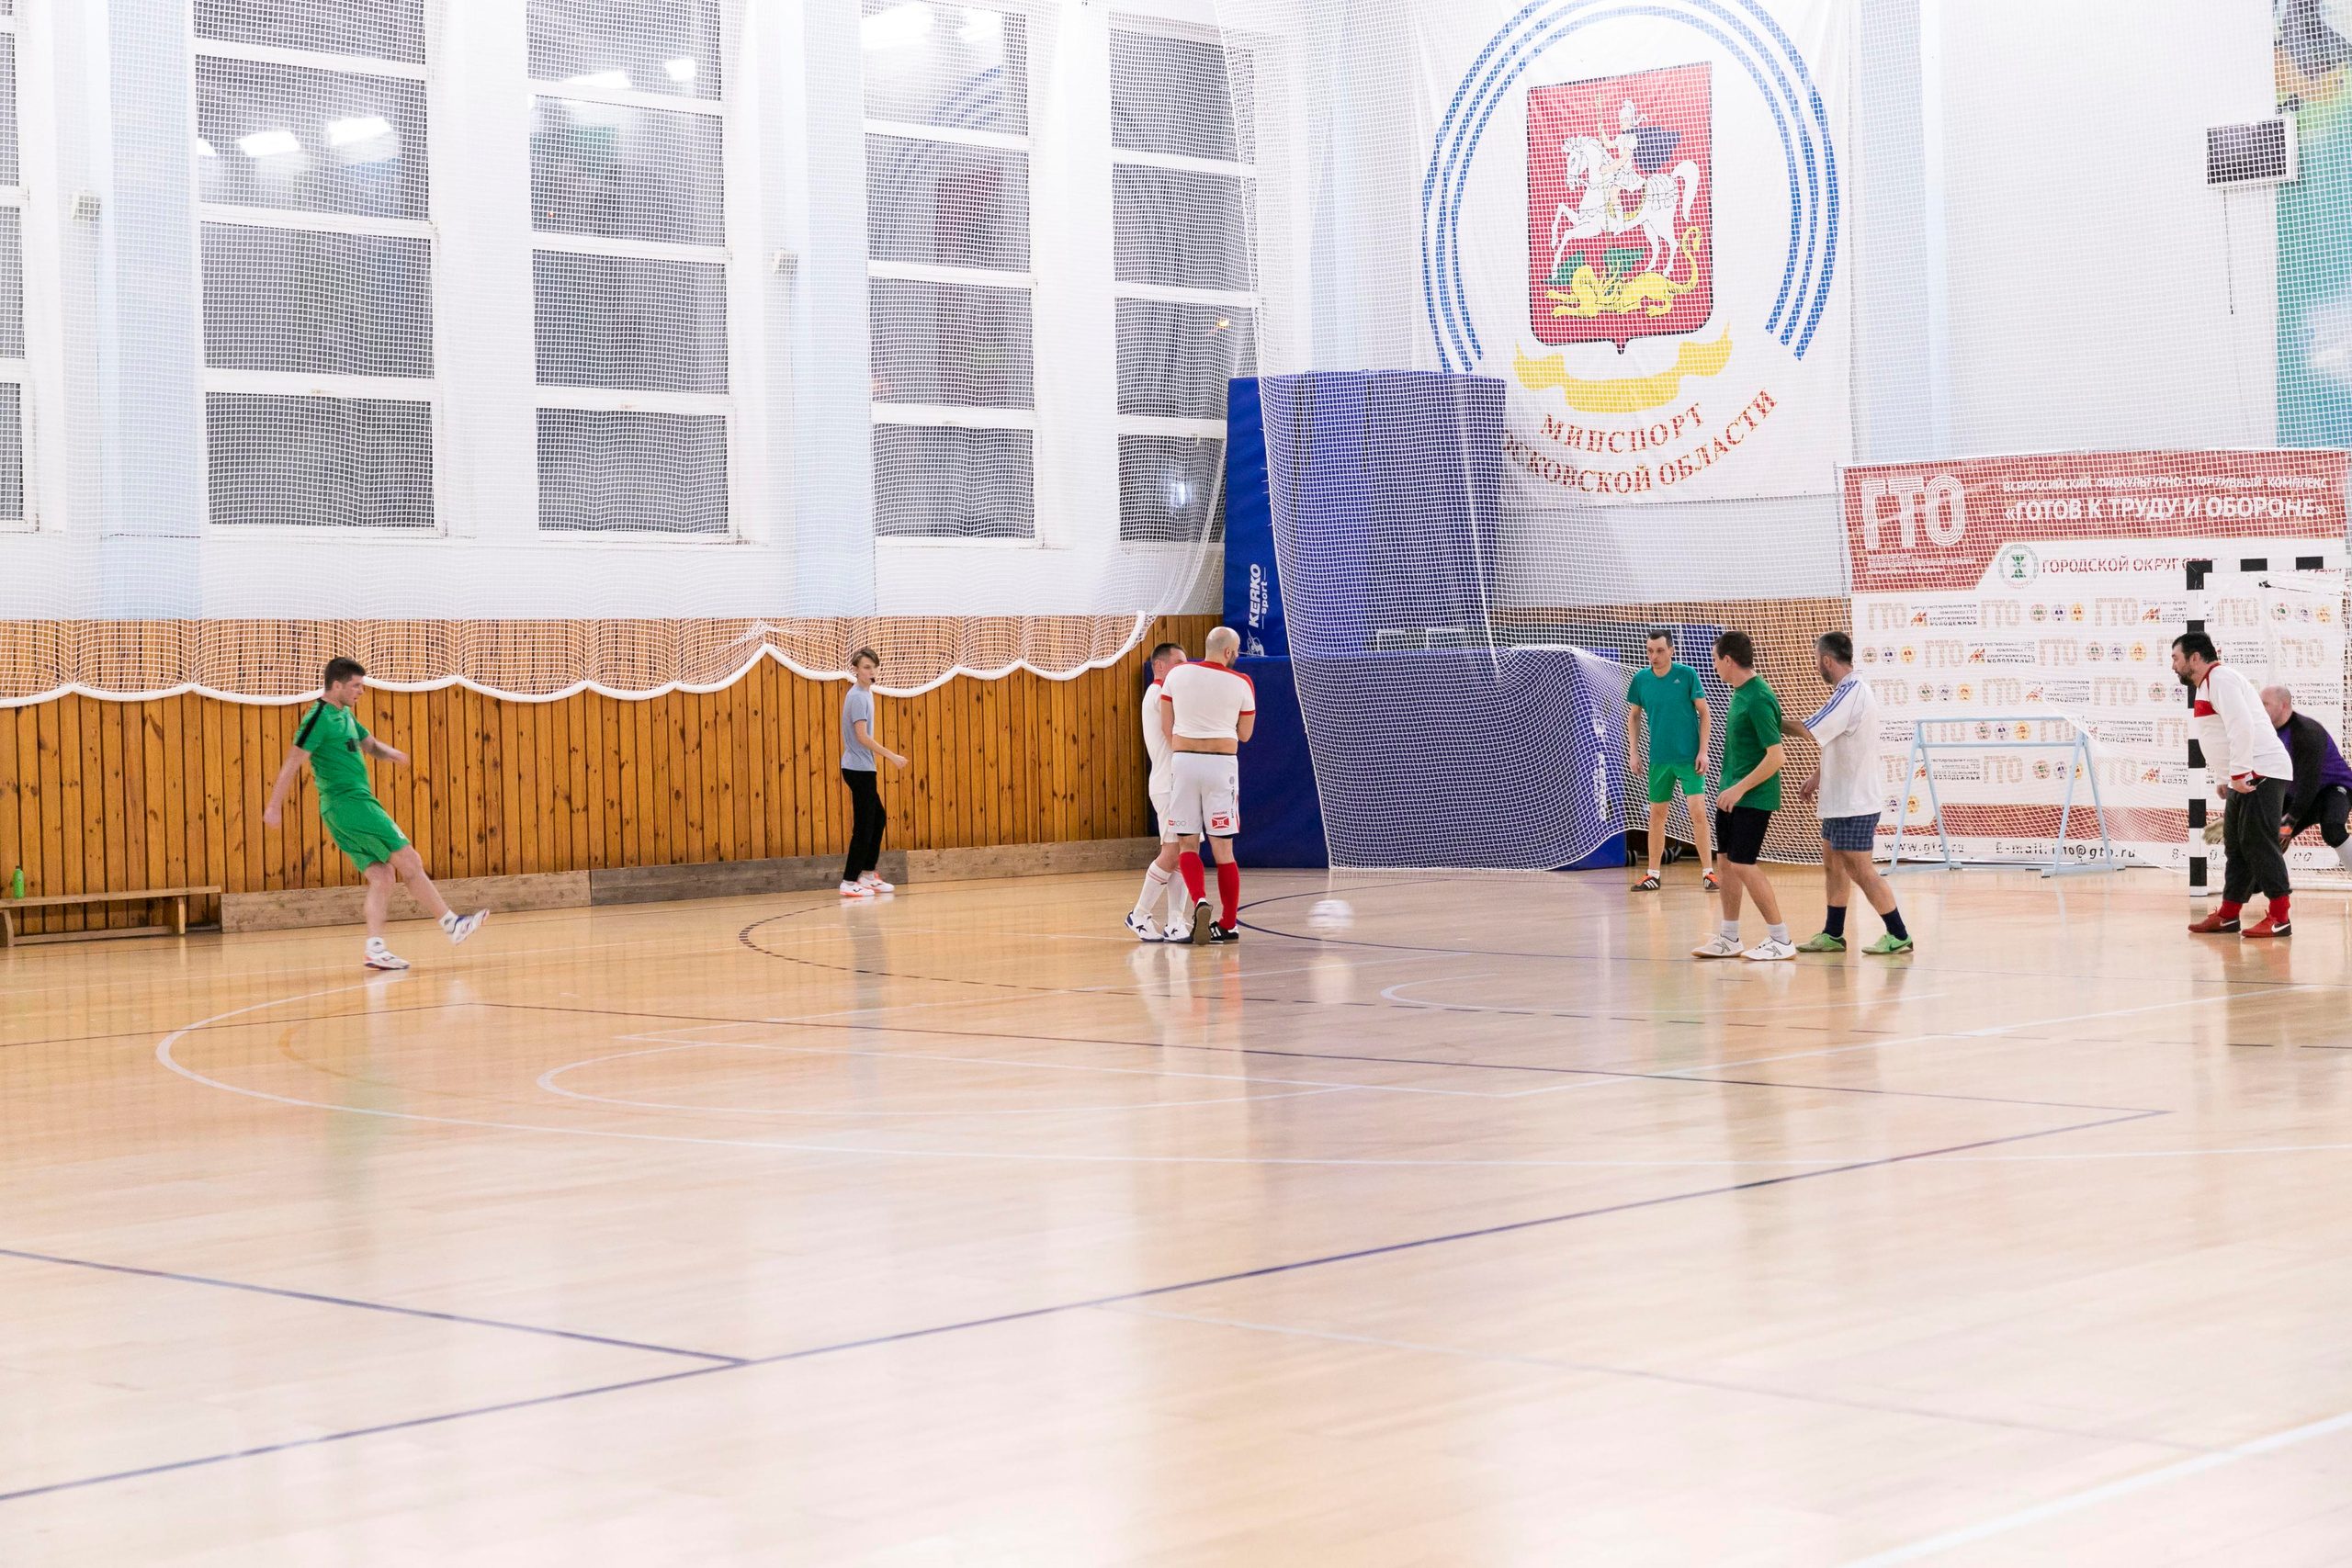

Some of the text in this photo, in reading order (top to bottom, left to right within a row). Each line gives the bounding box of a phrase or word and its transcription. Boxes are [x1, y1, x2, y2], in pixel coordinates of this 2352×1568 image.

[1503, 387, 1779, 493] СКОВСКОЙ ОБЛАСТИ
[1541, 402, 1704, 453] МИНСПОРТ
[2004, 476, 2330, 491] ВСЕРОССИЙСКИЙ ФИЗКУЛЬТУРНО-СПОРТИВНЫЙ КОМПЛЕКС
[2004, 496, 2327, 521] «ГОТОВ К ТРУДУ И ОБОРОНЕ»
[1861, 476, 1965, 549] ГТО
[2042, 555, 2129, 573] ГОРОДСКОЙ
[2132, 558, 2179, 571] ОКРУГ
[1249, 564, 1261, 627] KERKO
